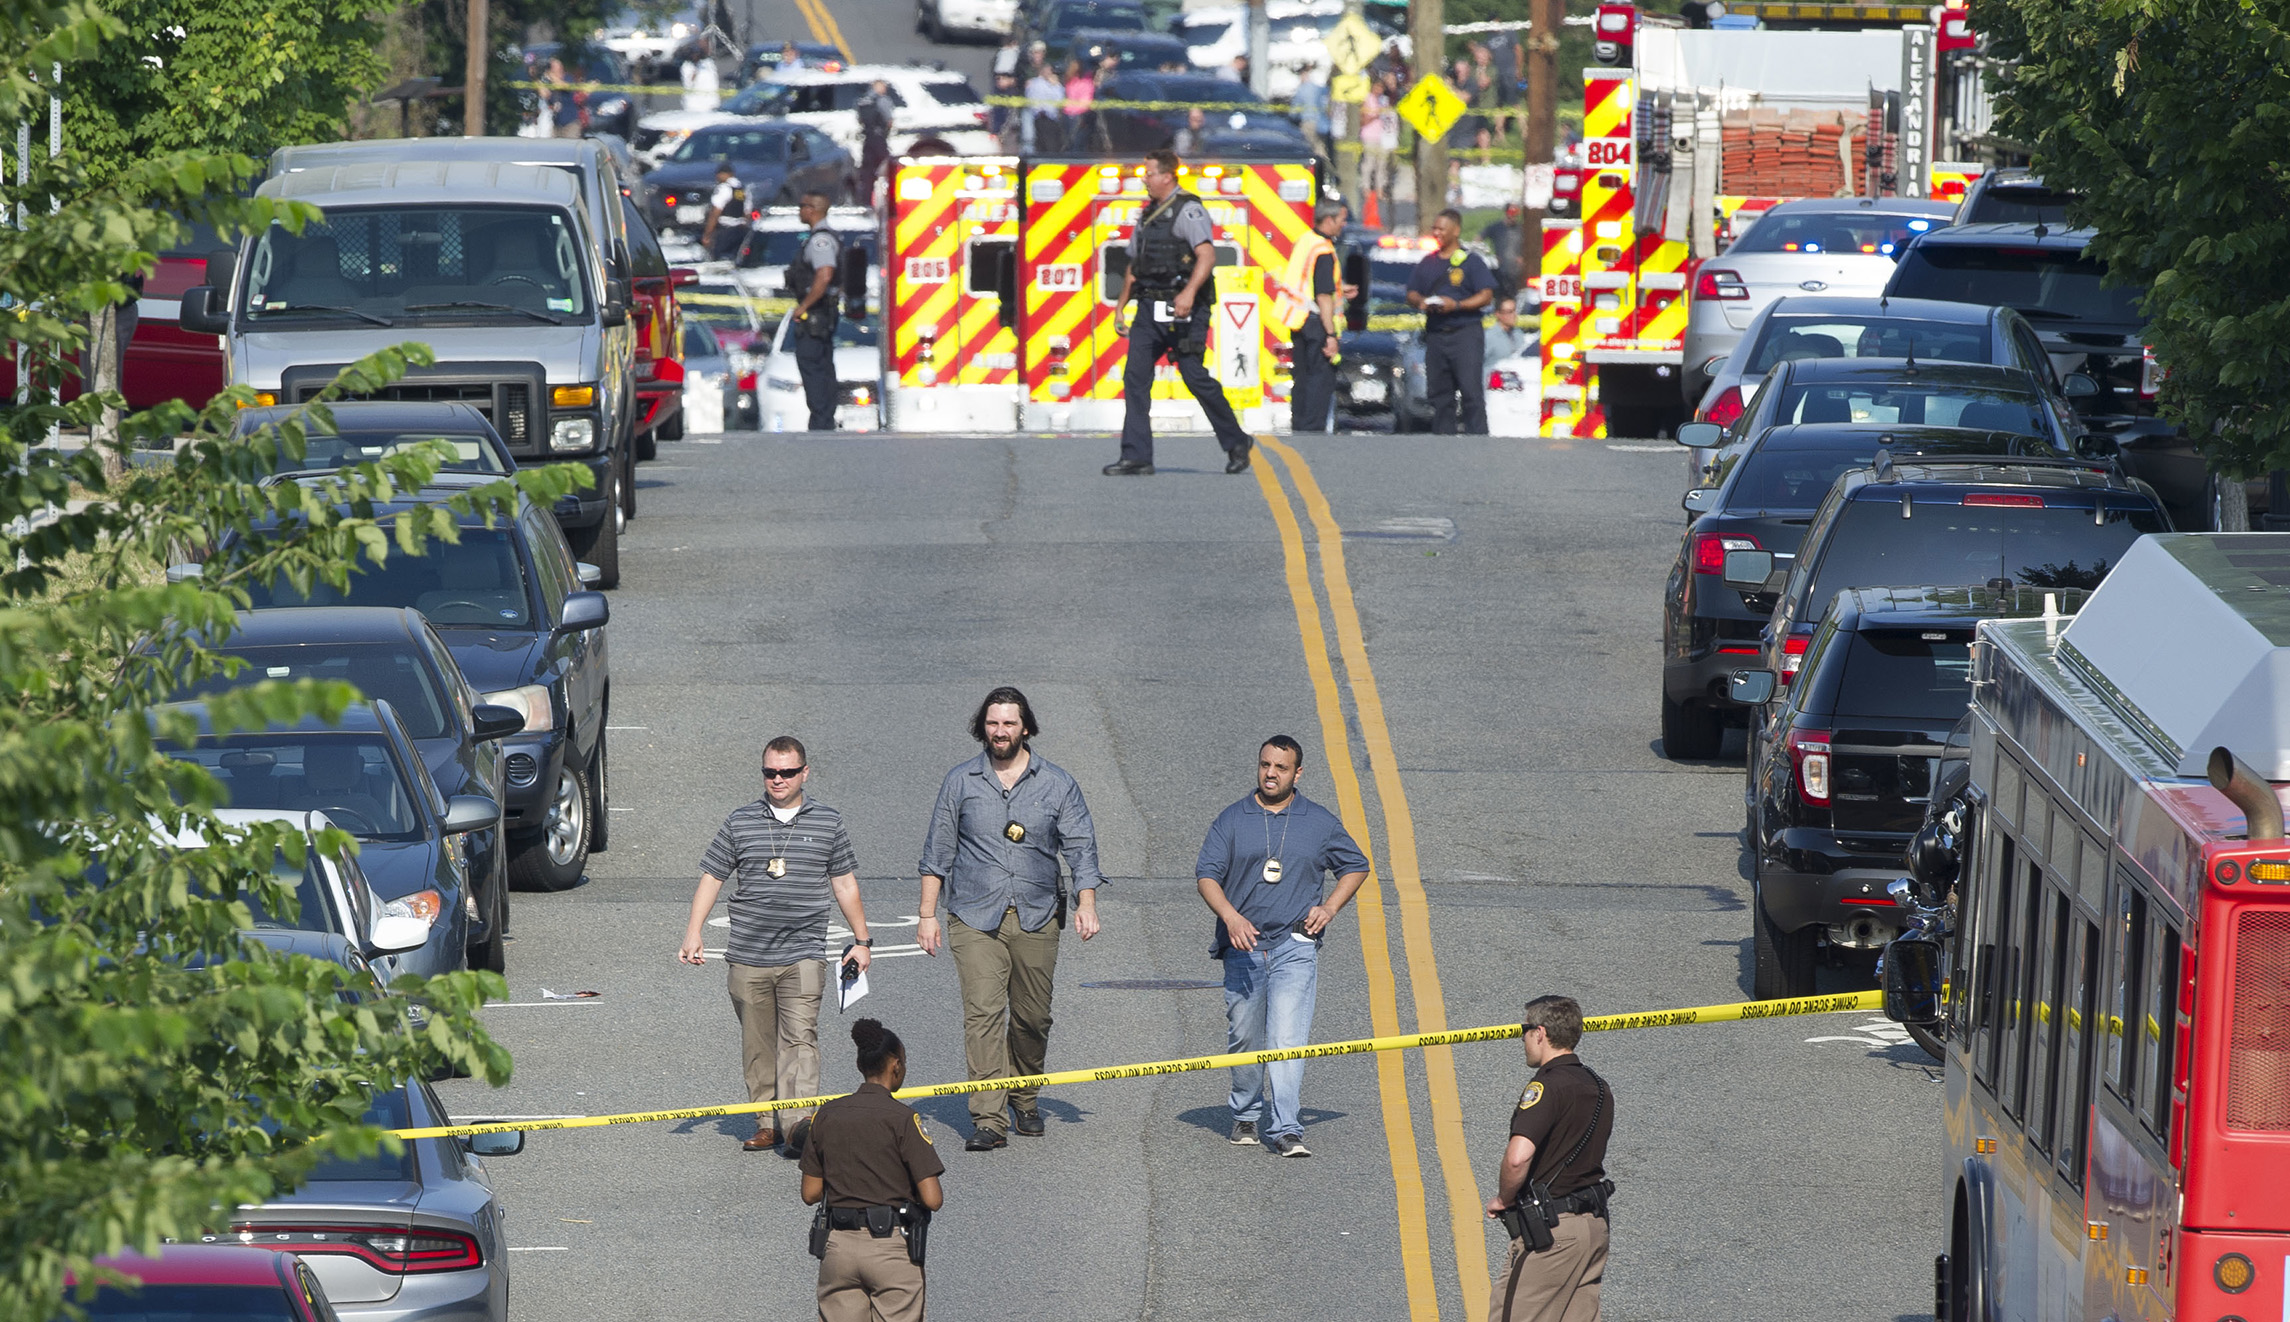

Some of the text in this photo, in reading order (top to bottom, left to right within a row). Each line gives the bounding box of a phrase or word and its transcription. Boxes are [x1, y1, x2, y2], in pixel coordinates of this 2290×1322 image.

[1905, 30, 1925, 198] ALEXANDRIA
[1740, 996, 1858, 1019] CRIME SCENE DO NOT CROSS
[1508, 1028, 1522, 1038] IME
